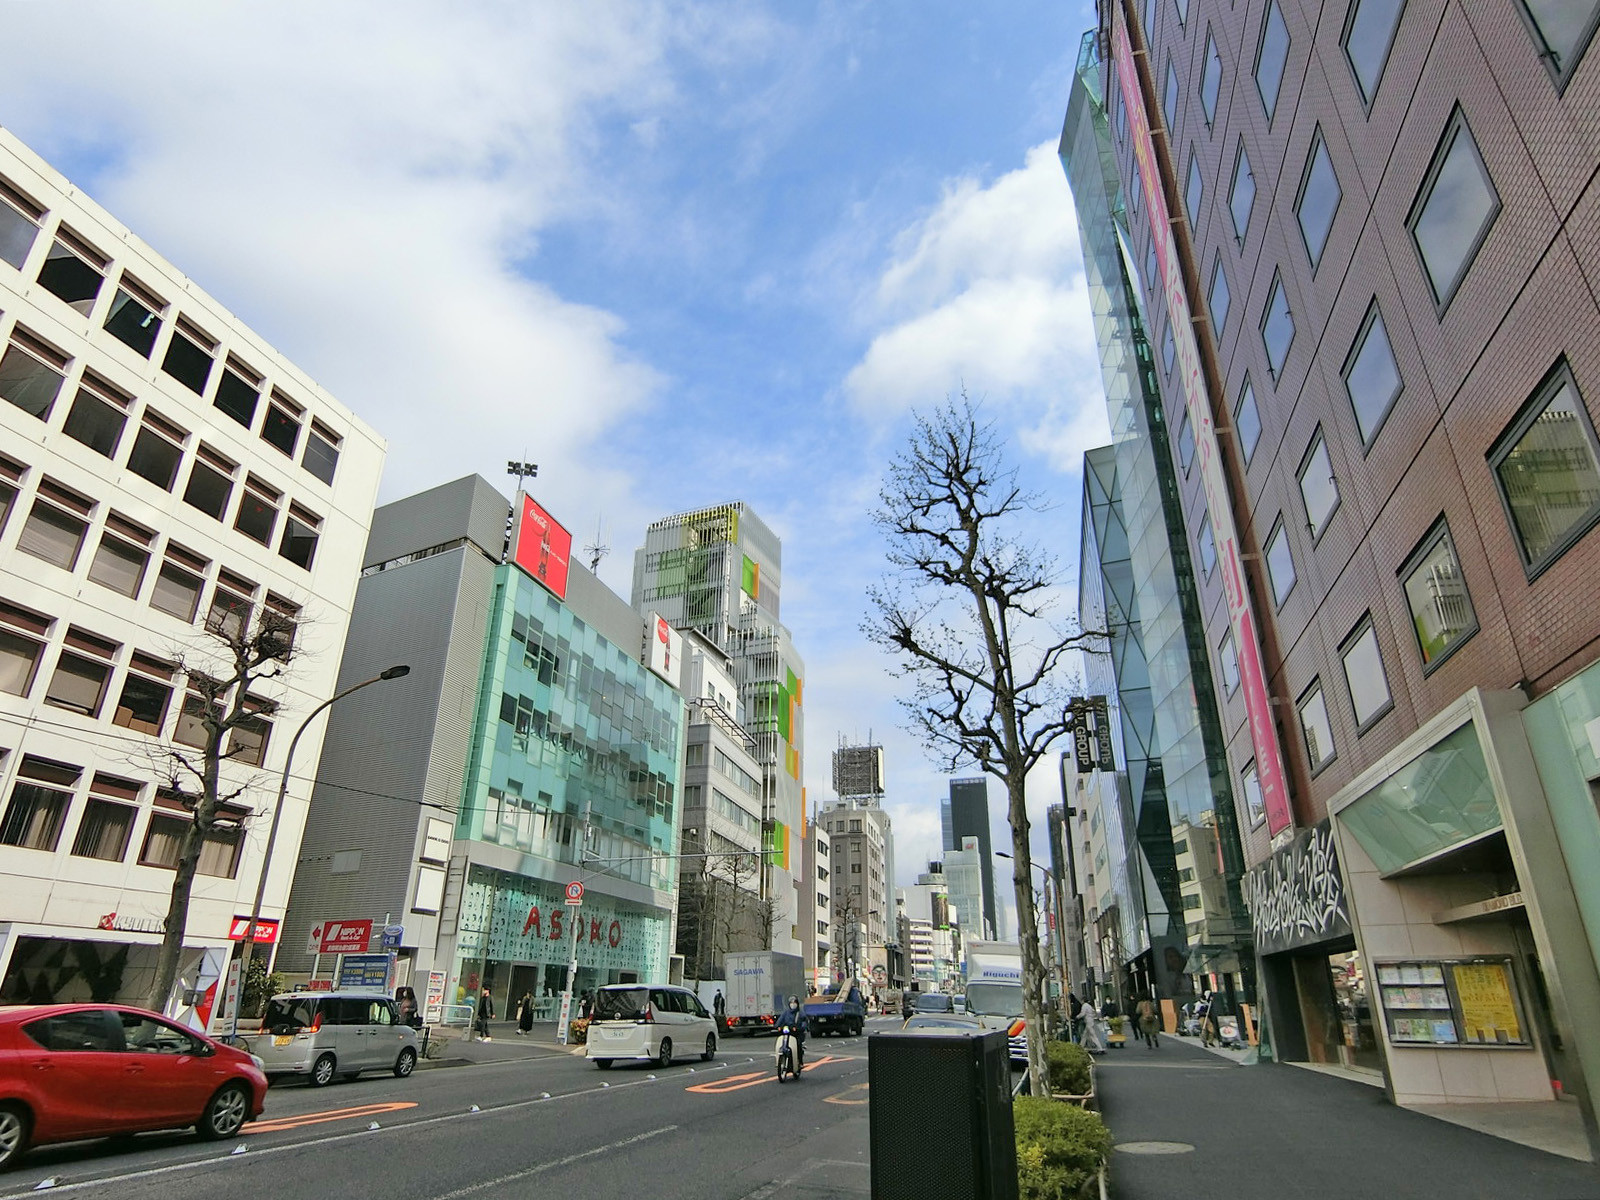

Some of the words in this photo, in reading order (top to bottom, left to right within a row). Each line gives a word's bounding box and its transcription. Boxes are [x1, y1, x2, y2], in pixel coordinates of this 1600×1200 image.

[1075, 726, 1089, 765] GROUP
[340, 927, 365, 936] NIPPON
[521, 906, 622, 948] ASOKO
[733, 968, 764, 976] SAGAWA
[982, 971, 1020, 979] Higuchi
